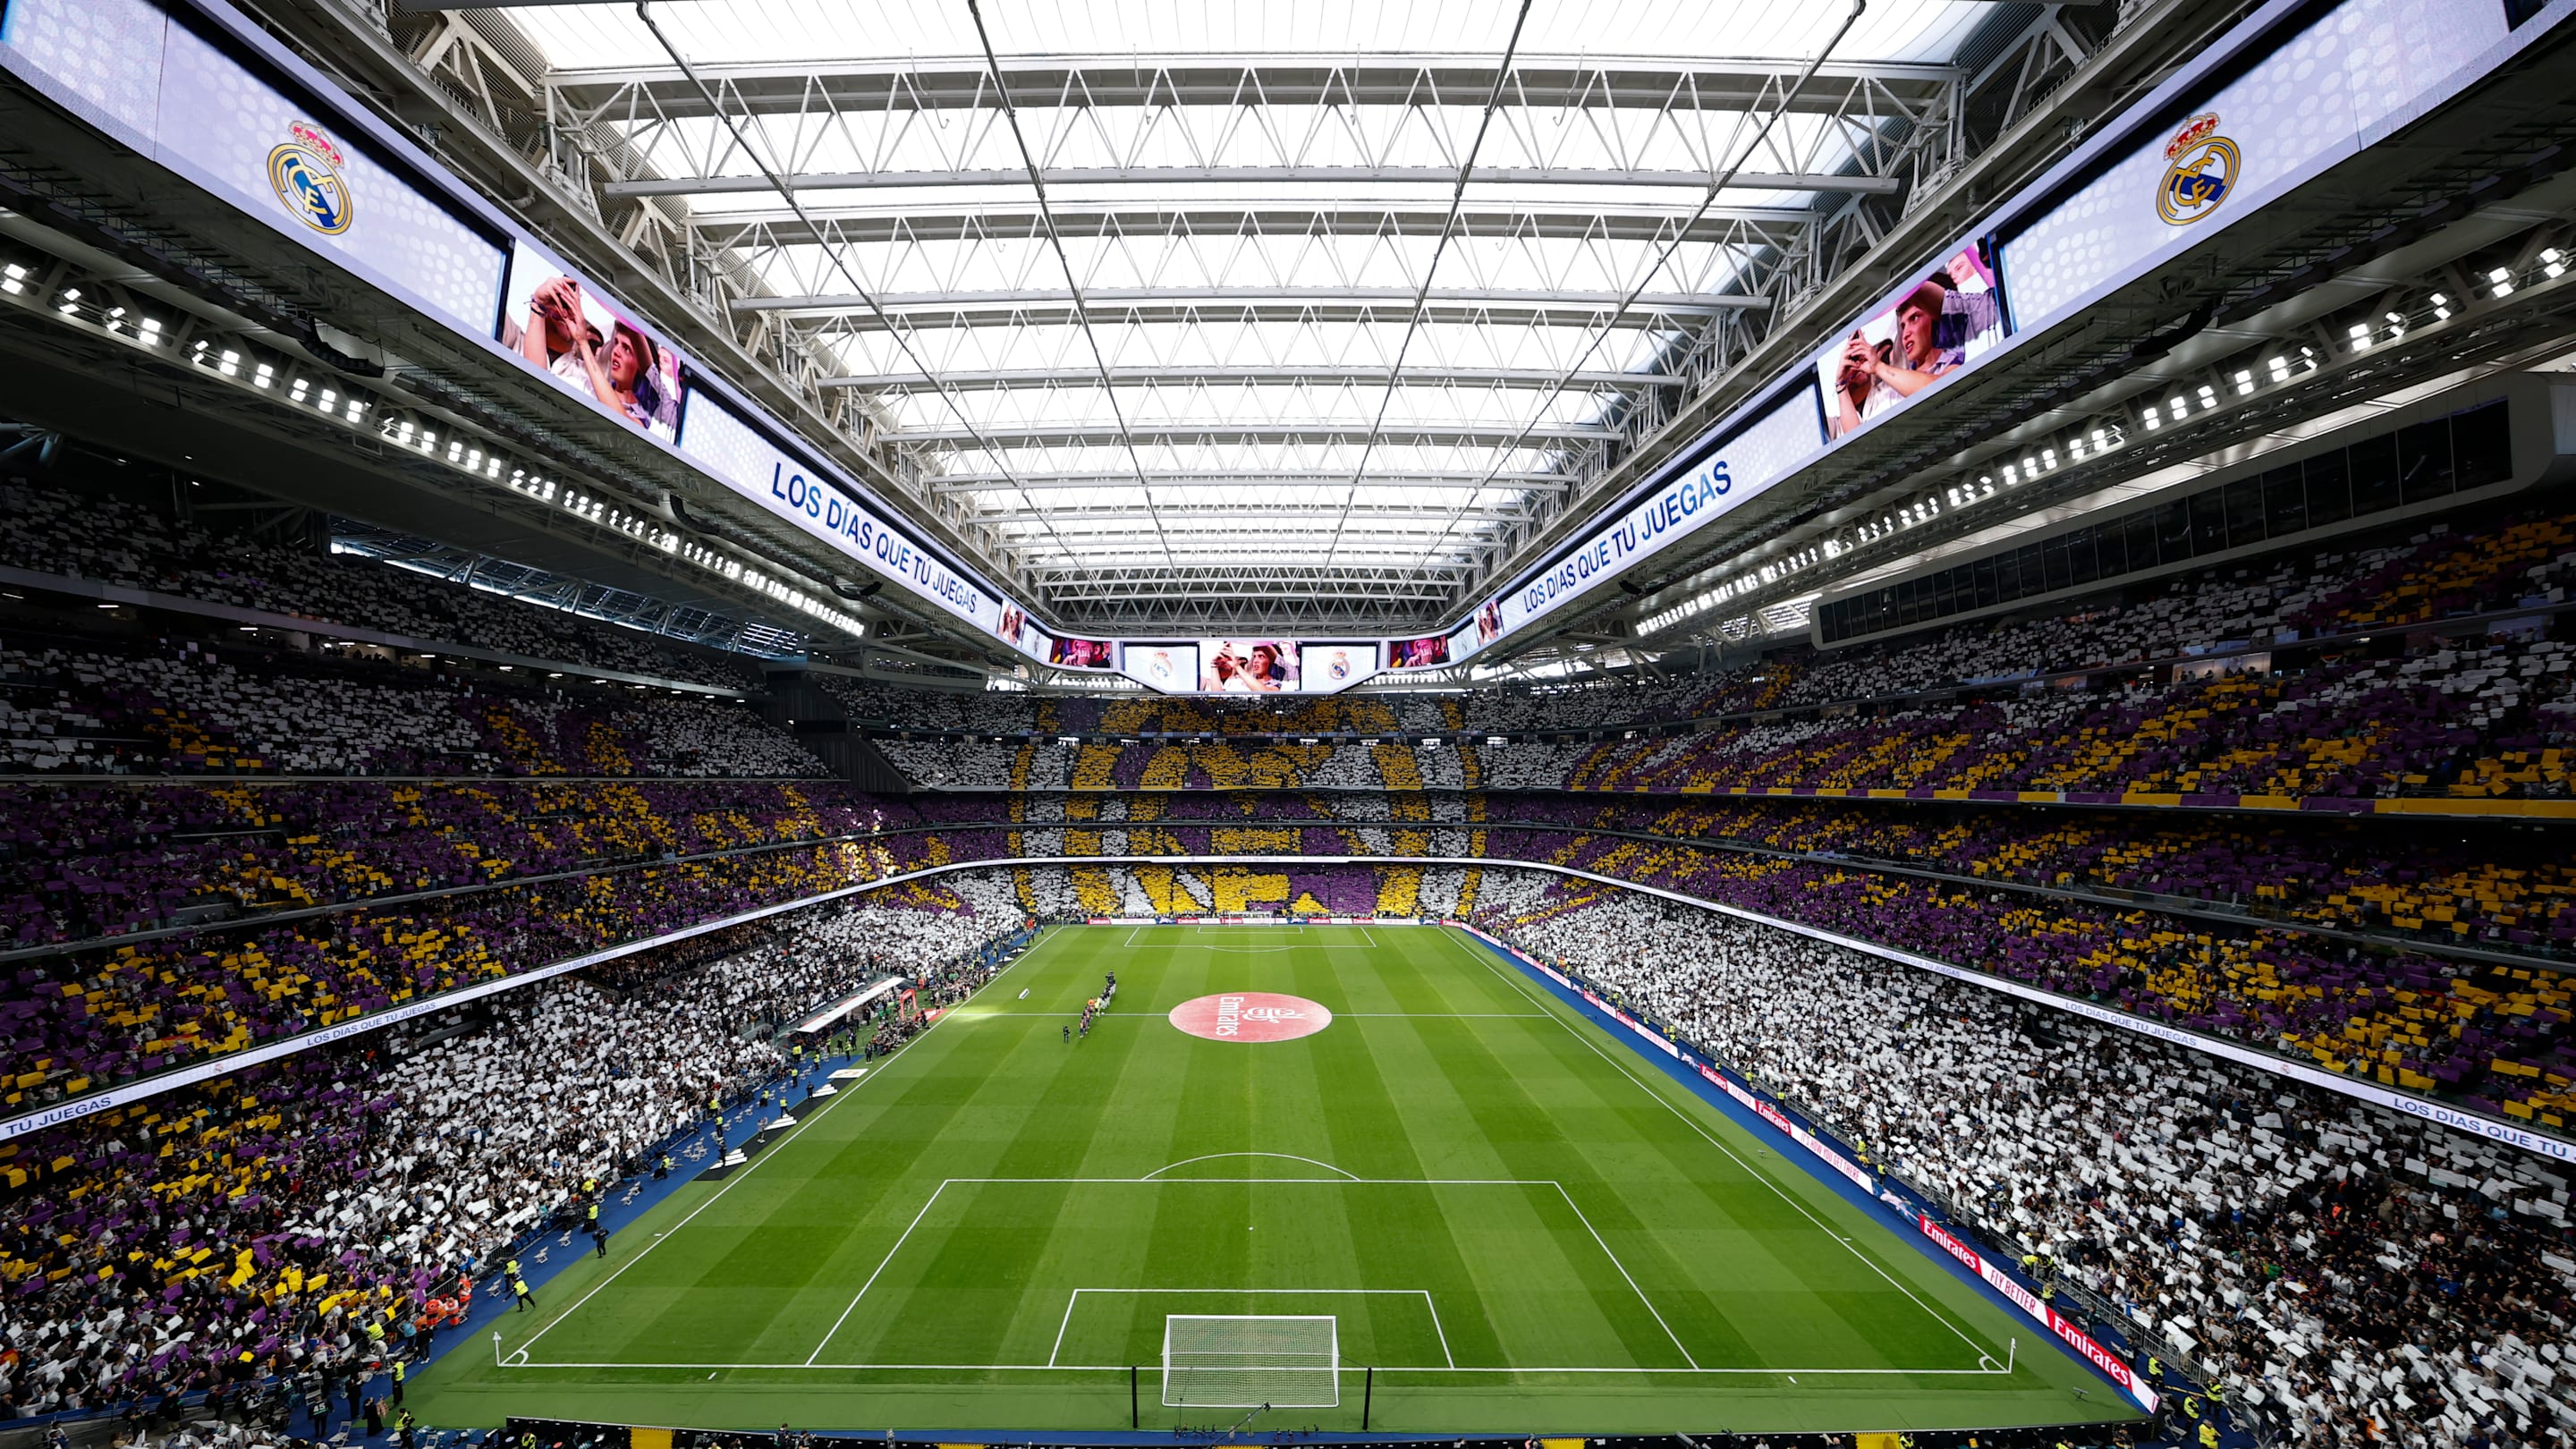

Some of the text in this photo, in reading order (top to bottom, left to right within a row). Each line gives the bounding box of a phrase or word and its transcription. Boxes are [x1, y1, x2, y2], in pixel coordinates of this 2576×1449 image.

[772, 462, 978, 614] LOS DÍAS QUE TÚ JUEGAS
[1523, 461, 1732, 614] LOS DÍAS QUE TÚ JUEGAS
[307, 1033, 330, 1046] LOS
[360, 1018, 383, 1030] QUE
[400, 1002, 436, 1019] JUEGAS
[1216, 996, 1244, 1036] Emirates
[2065, 1001, 2083, 1013] LOS
[2111, 1015, 2132, 1028] QUE
[2151, 1027, 2197, 1046] JUEGAS
[1702, 1067, 1727, 1090] Emirates
[5, 1097, 112, 1135] TÚ JUEGAS
[1758, 1102, 1789, 1132] Emirates
[2394, 1097, 2567, 1157] LOS DÍAS QUE TÚ
[1823, 1144, 1833, 1162] YOU
[1834, 1153, 1843, 1170] GET
[1843, 1160, 1860, 1182] THERE
[1923, 1218, 1977, 1269] Emirates
[1990, 1268, 2036, 1314] FLY BETTER
[2054, 1315, 2130, 1385] Emirates
[313, 1402, 326, 1412] 45
